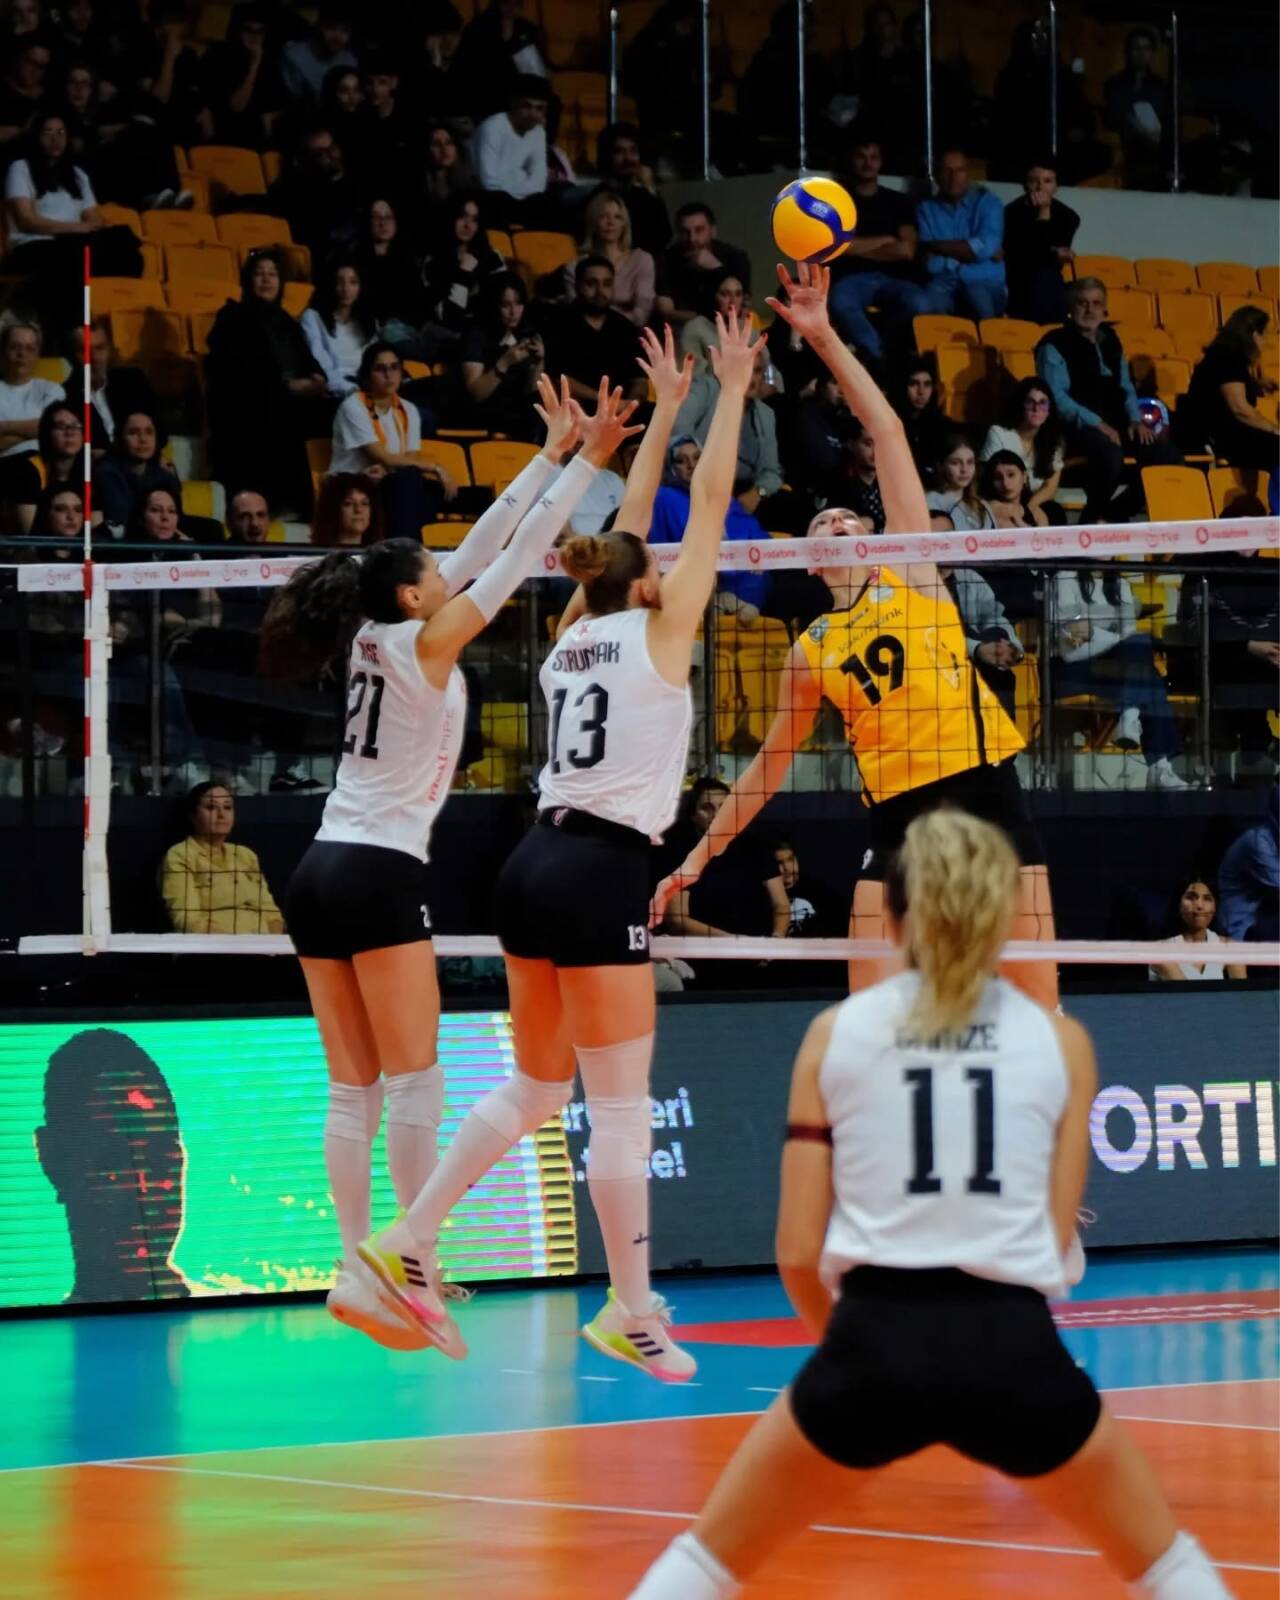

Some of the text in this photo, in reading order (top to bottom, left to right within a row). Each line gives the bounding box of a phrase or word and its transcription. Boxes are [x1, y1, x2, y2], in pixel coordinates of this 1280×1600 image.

[343, 671, 385, 761] 21
[839, 634, 905, 707] 19
[551, 682, 609, 774] 13
[627, 925, 647, 950] 13
[904, 1066, 1002, 1193] 11
[1088, 1081, 1278, 1174] ORTI
